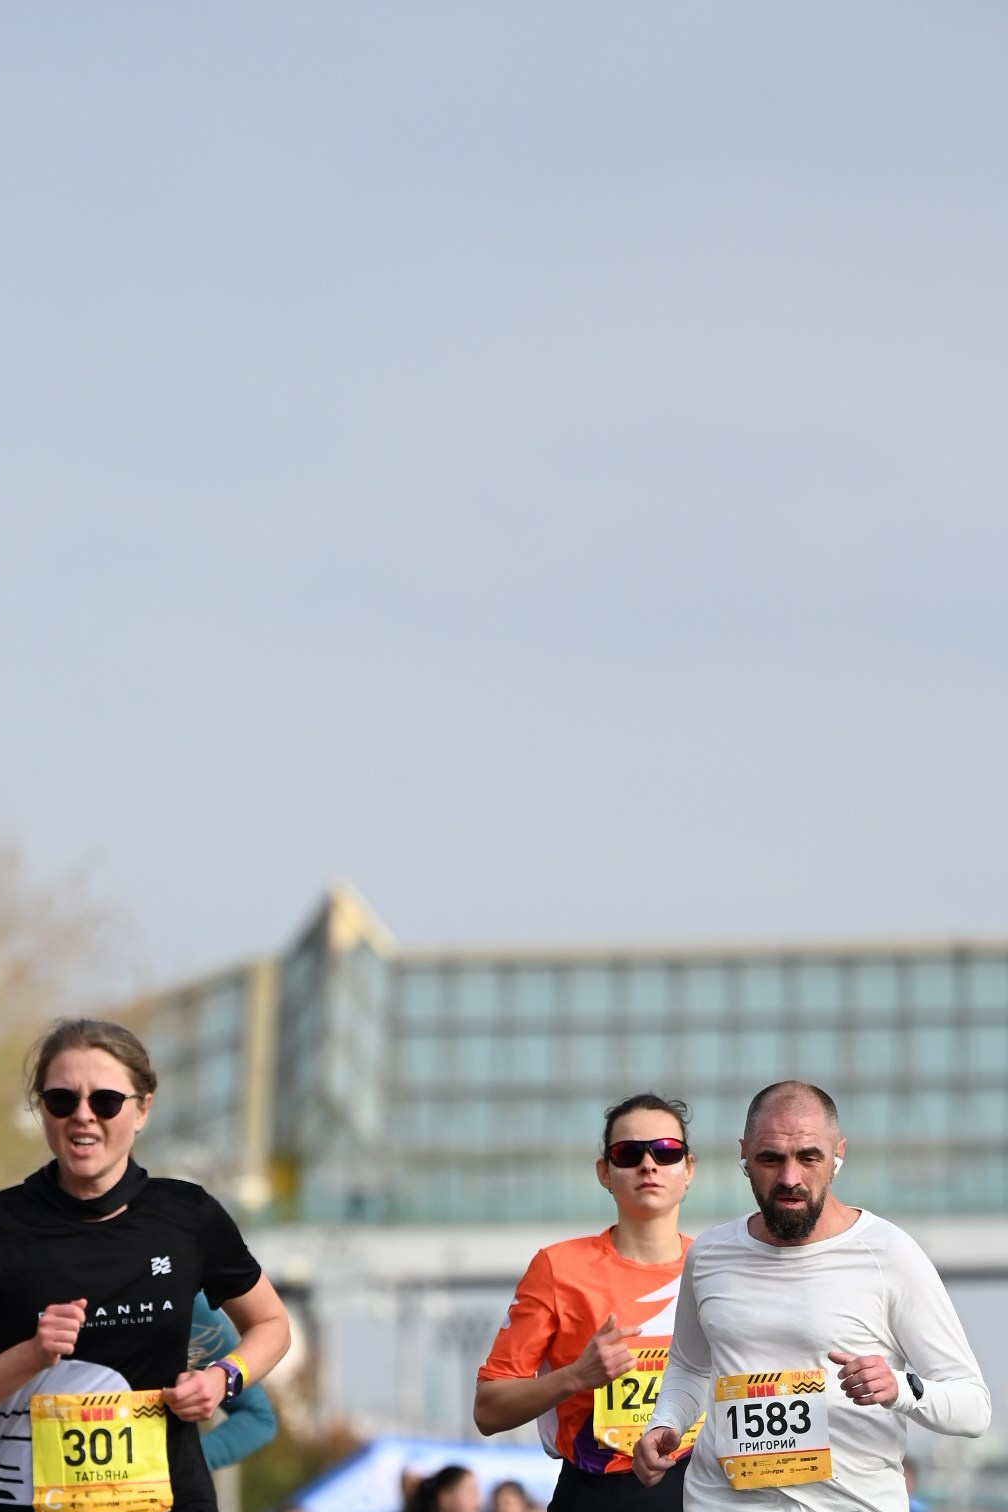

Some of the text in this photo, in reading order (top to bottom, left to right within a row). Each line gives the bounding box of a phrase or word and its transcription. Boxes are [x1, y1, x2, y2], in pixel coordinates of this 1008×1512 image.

[122, 1316, 154, 1325] CLUB
[791, 1371, 801, 1381] 10
[726, 1400, 812, 1440] 1583
[63, 1426, 134, 1467] 301
[739, 1437, 796, 1453] ГРИГОРИЙ
[75, 1470, 129, 1482] ТАТЬЯНА
